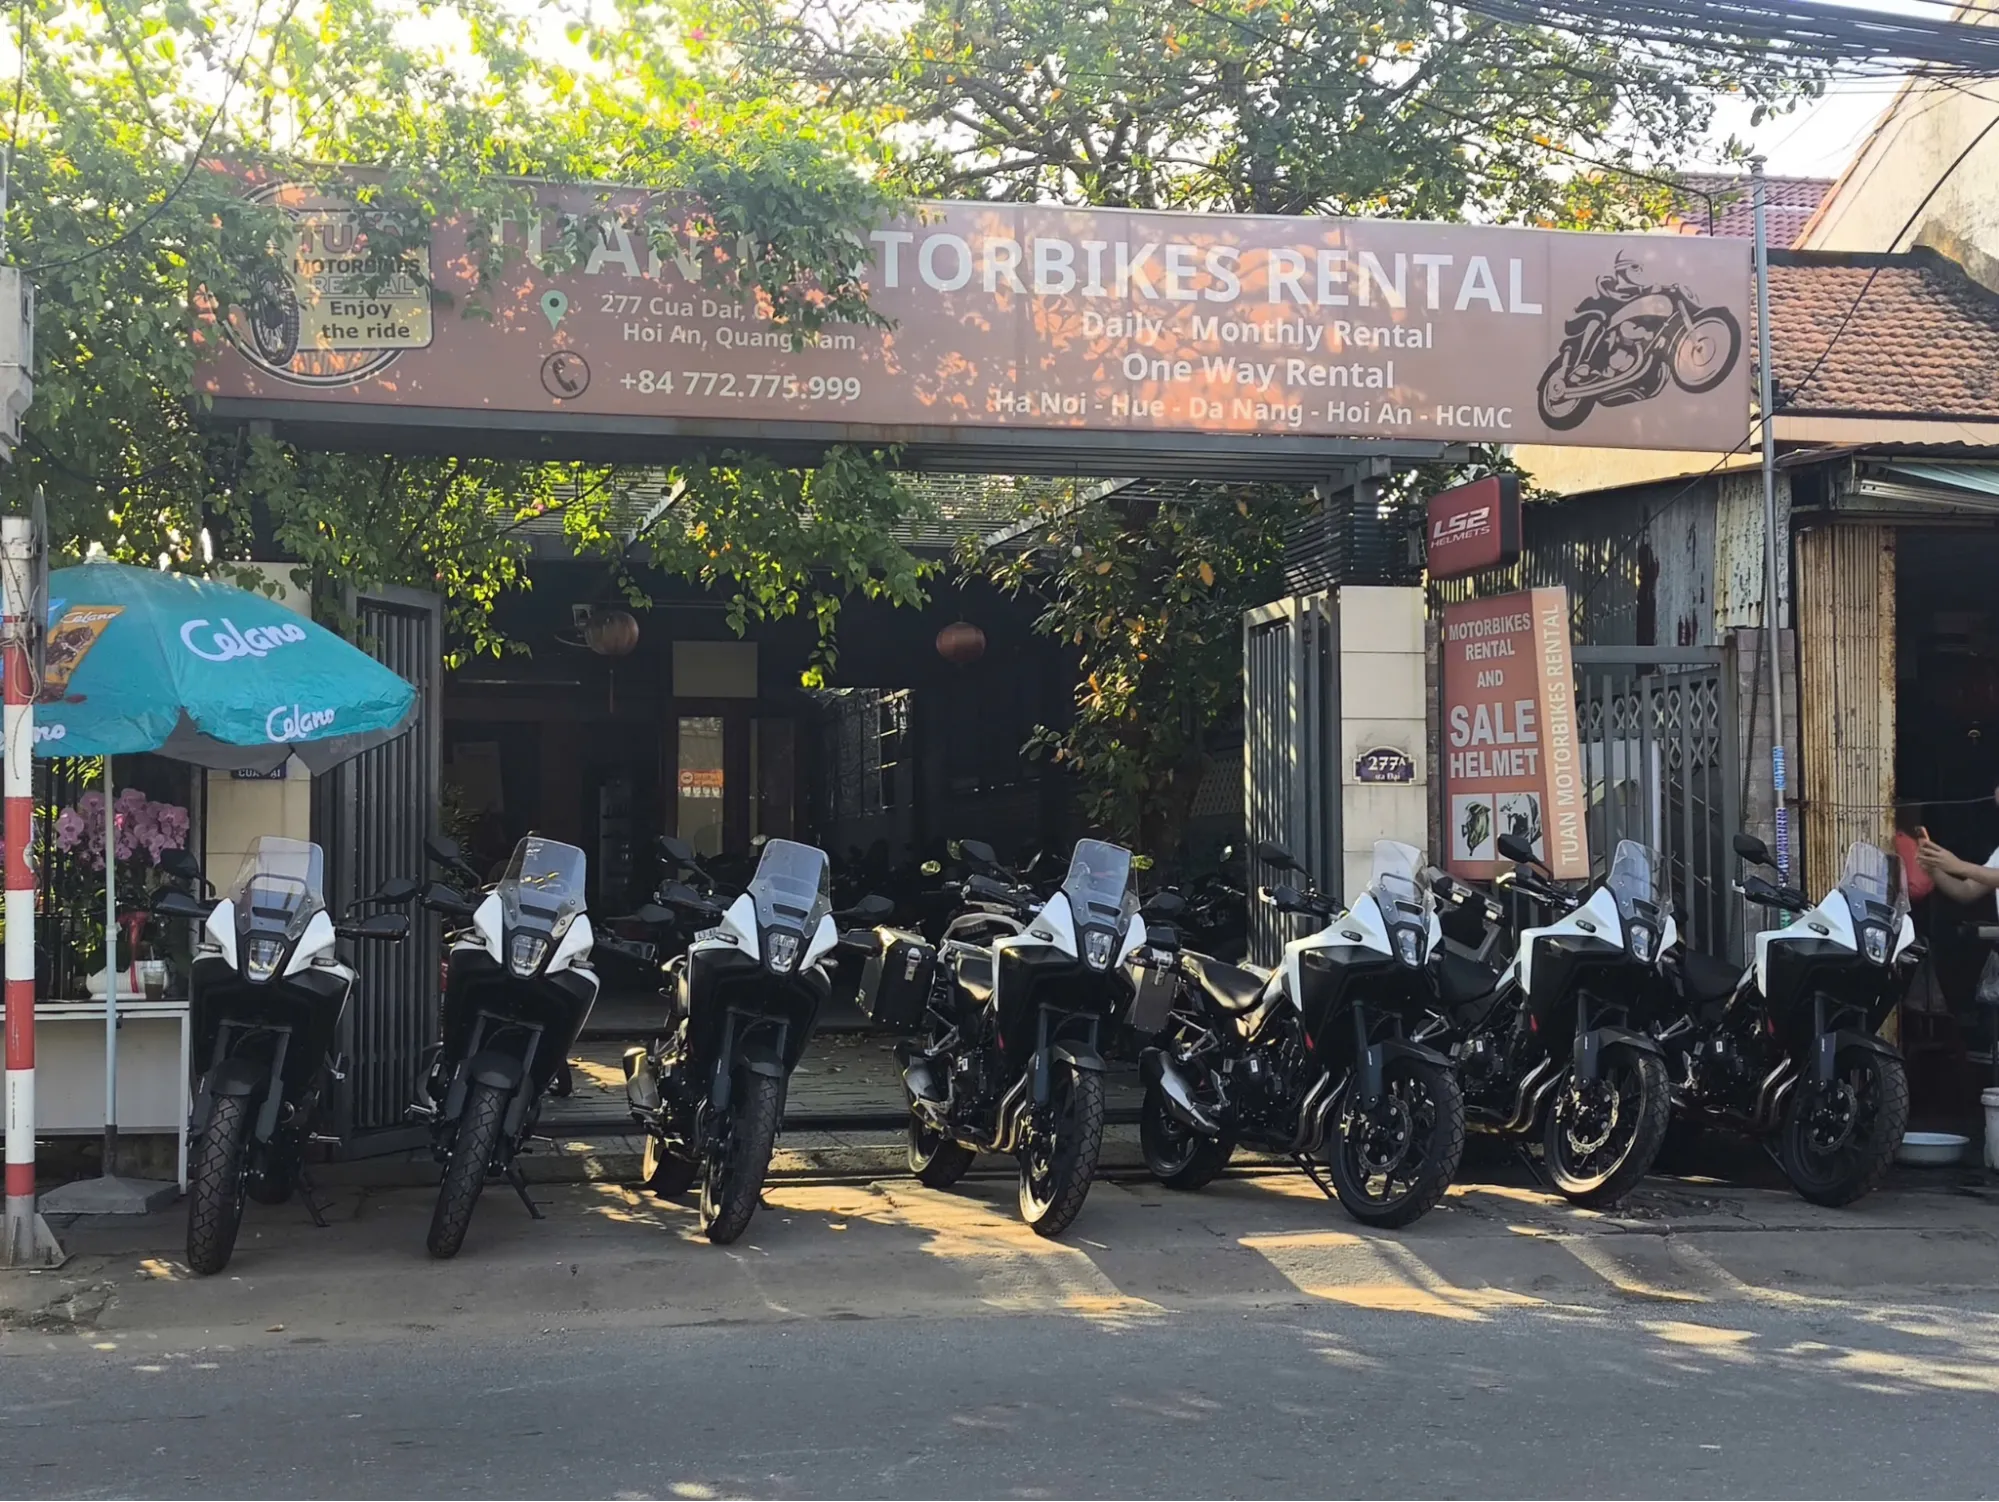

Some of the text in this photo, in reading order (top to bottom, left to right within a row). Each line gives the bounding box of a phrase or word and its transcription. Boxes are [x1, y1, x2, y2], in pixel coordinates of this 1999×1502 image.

[309, 276, 416, 295] REAL
[736, 228, 1241, 302] TORBIKES
[1267, 248, 1542, 315] RENTAL
[330, 300, 392, 318] Enjoy
[600, 294, 642, 314] 277
[649, 297, 694, 317] Cua
[322, 322, 411, 339] the ride
[623, 323, 662, 343] Hoi
[669, 325, 706, 346] An,
[716, 327, 793, 353] Quang
[1082, 311, 1163, 346] Daily
[1192, 315, 1324, 352] Monthly
[1333, 320, 1433, 349] Rental
[620, 369, 861, 400] +84 772.775.999
[1123, 353, 1395, 392] One Way Rental
[995, 390, 1031, 413] Ha
[1041, 391, 1086, 415] Noi
[1111, 394, 1165, 417] Hue
[1189, 397, 1223, 419] Da
[1232, 398, 1303, 426] Nang
[1327, 401, 1370, 424] Hoi
[1377, 403, 1412, 425] An
[1436, 405, 1513, 429] HCMC
[1430, 525, 1491, 549] HELMETS
[1433, 506, 1490, 539] LS2
[180, 618, 306, 662] Celano
[1449, 612, 1531, 641] MOTORBIKES
[1465, 639, 1515, 661] RENTAL
[1477, 669, 1504, 688] AND
[266, 703, 335, 743] Celano
[1450, 699, 1538, 748] SALE
[1542, 604, 1579, 866] TUAN MOTORBIKES RENTAL
[1450, 748, 1538, 778] HELMET
